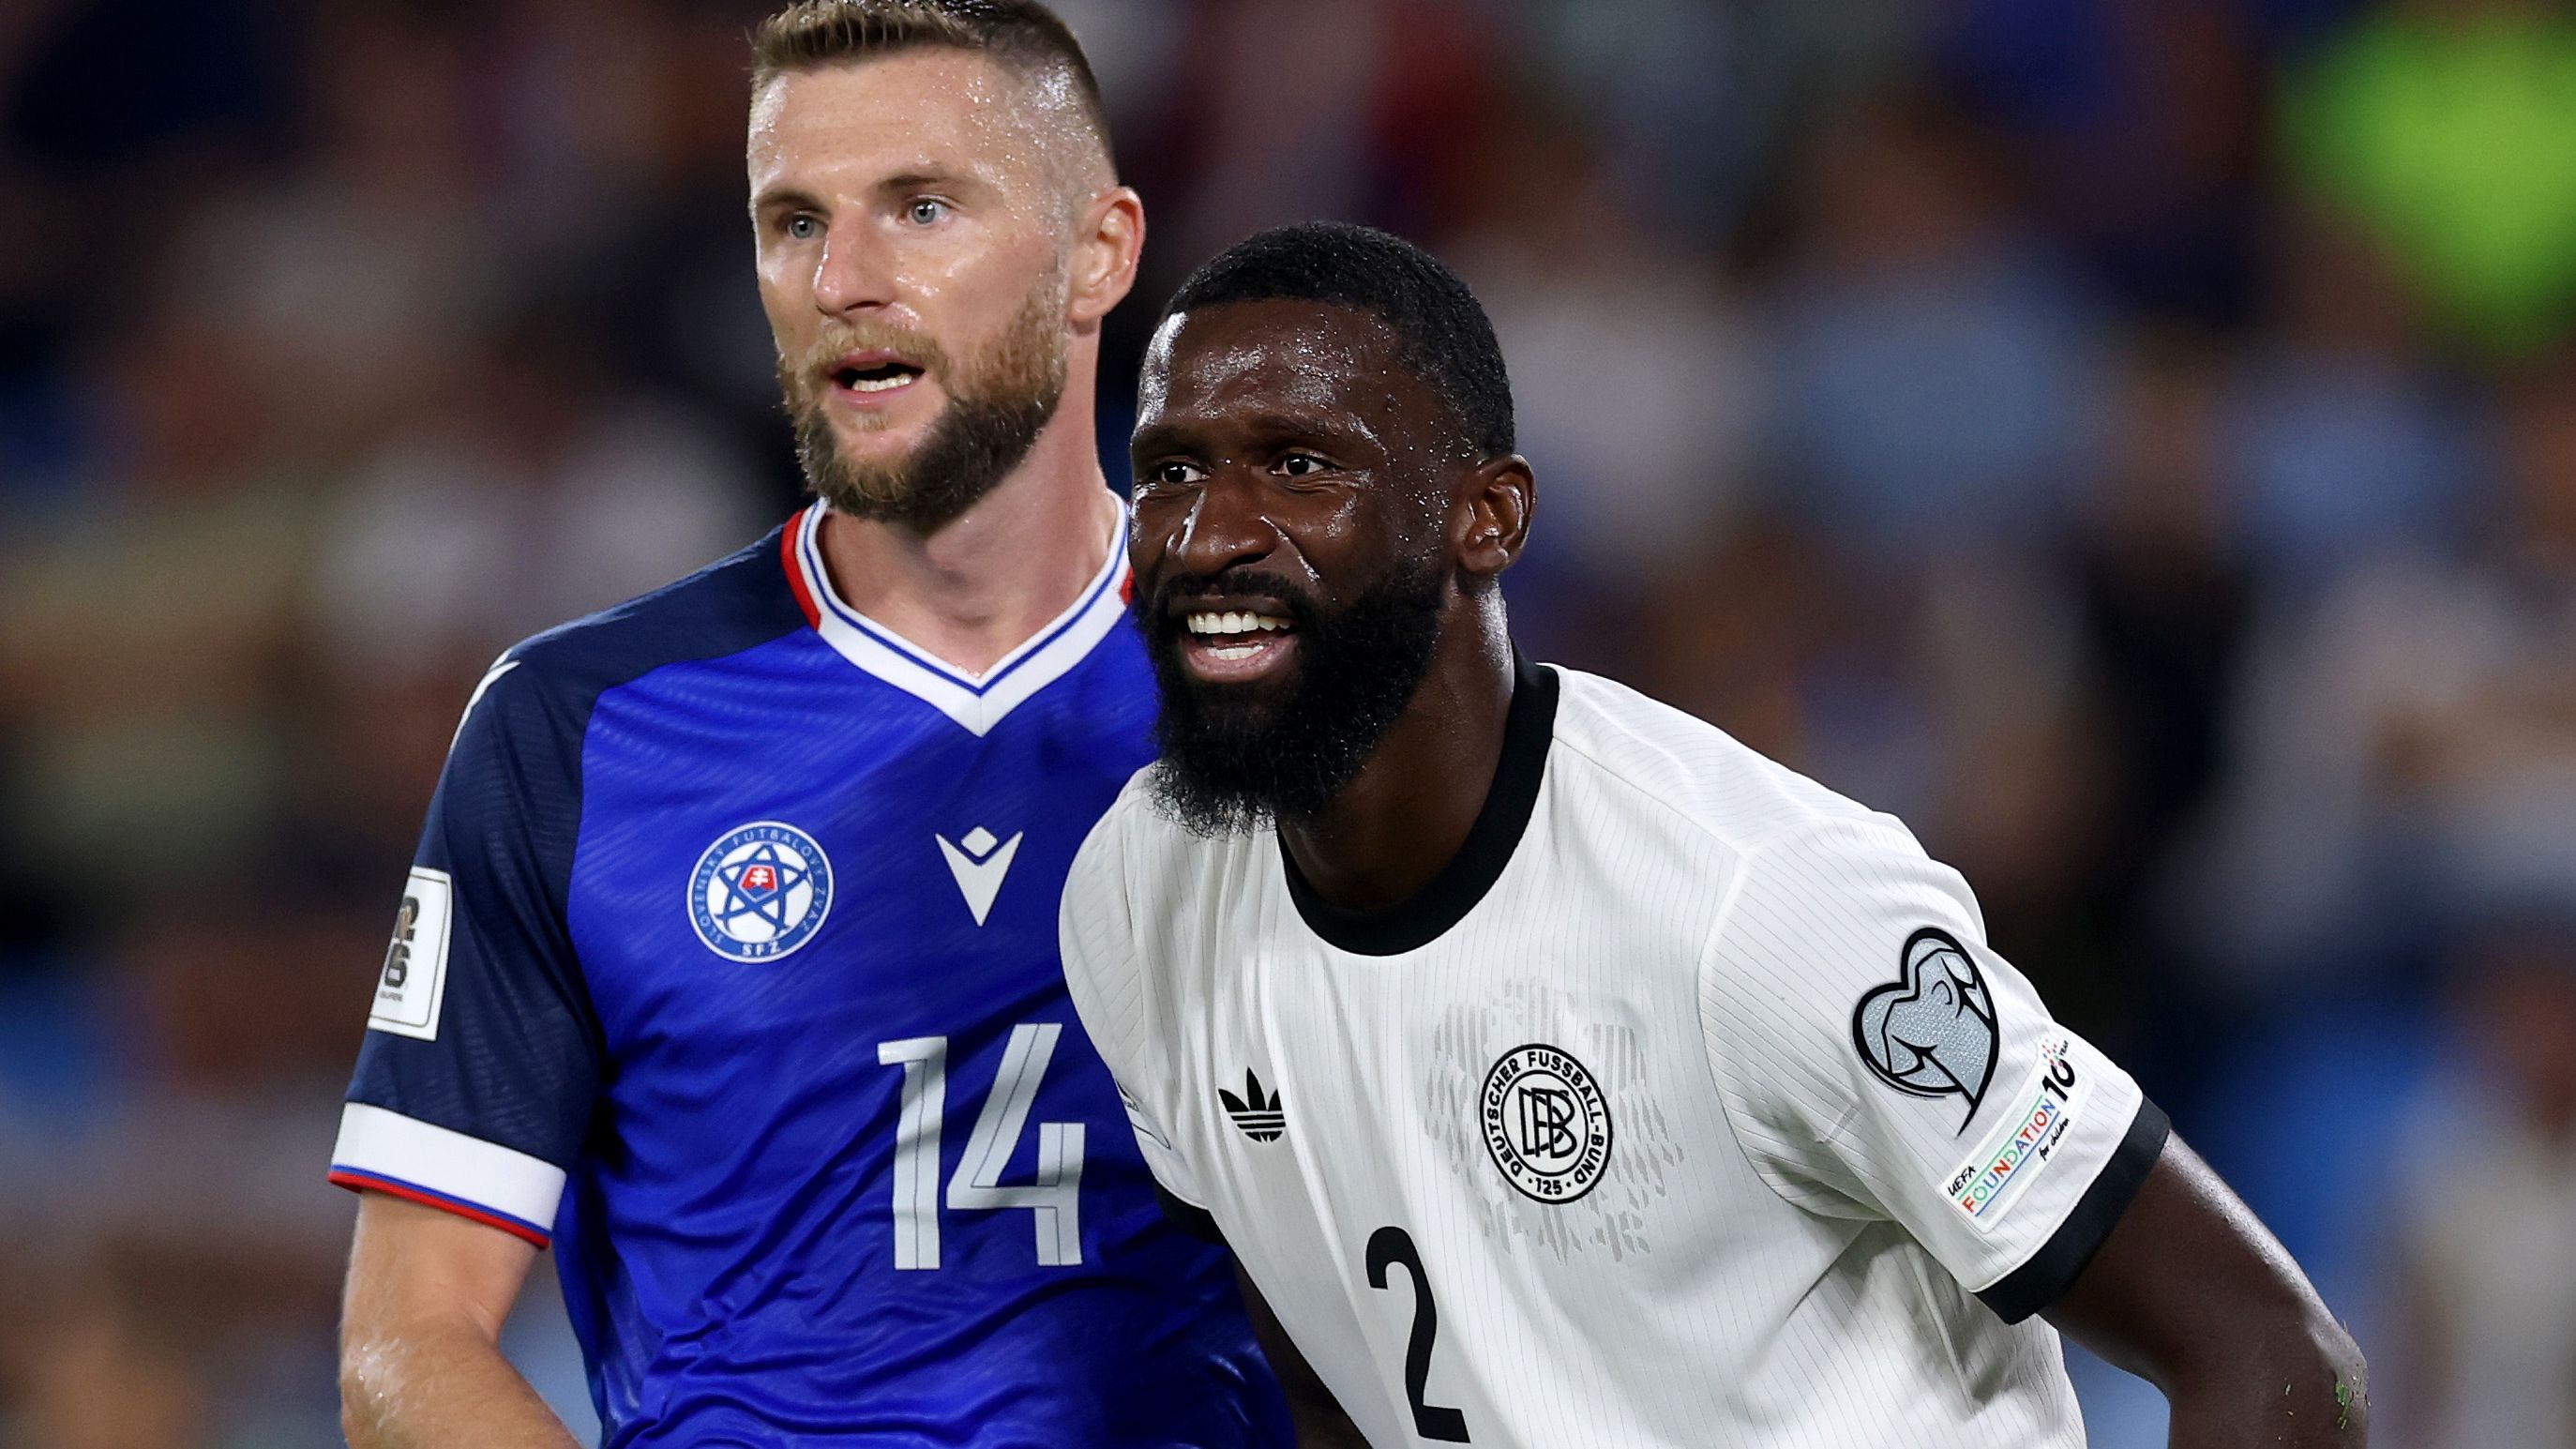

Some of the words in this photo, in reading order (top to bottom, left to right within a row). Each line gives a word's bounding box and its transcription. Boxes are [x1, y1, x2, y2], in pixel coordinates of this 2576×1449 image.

[742, 939, 781, 957] SFZ
[1487, 1058, 1524, 1177] DEUTSCHER
[1527, 1051, 1604, 1185] FUSSBALL-BUND
[2041, 1058, 2075, 1103] 10
[878, 1022, 1085, 1270] 14
[1535, 1177, 1562, 1195] 125
[1948, 1165, 1977, 1197] UEFA
[1962, 1098, 2056, 1213] FOUNDATION
[1365, 1226, 1471, 1443] 2
